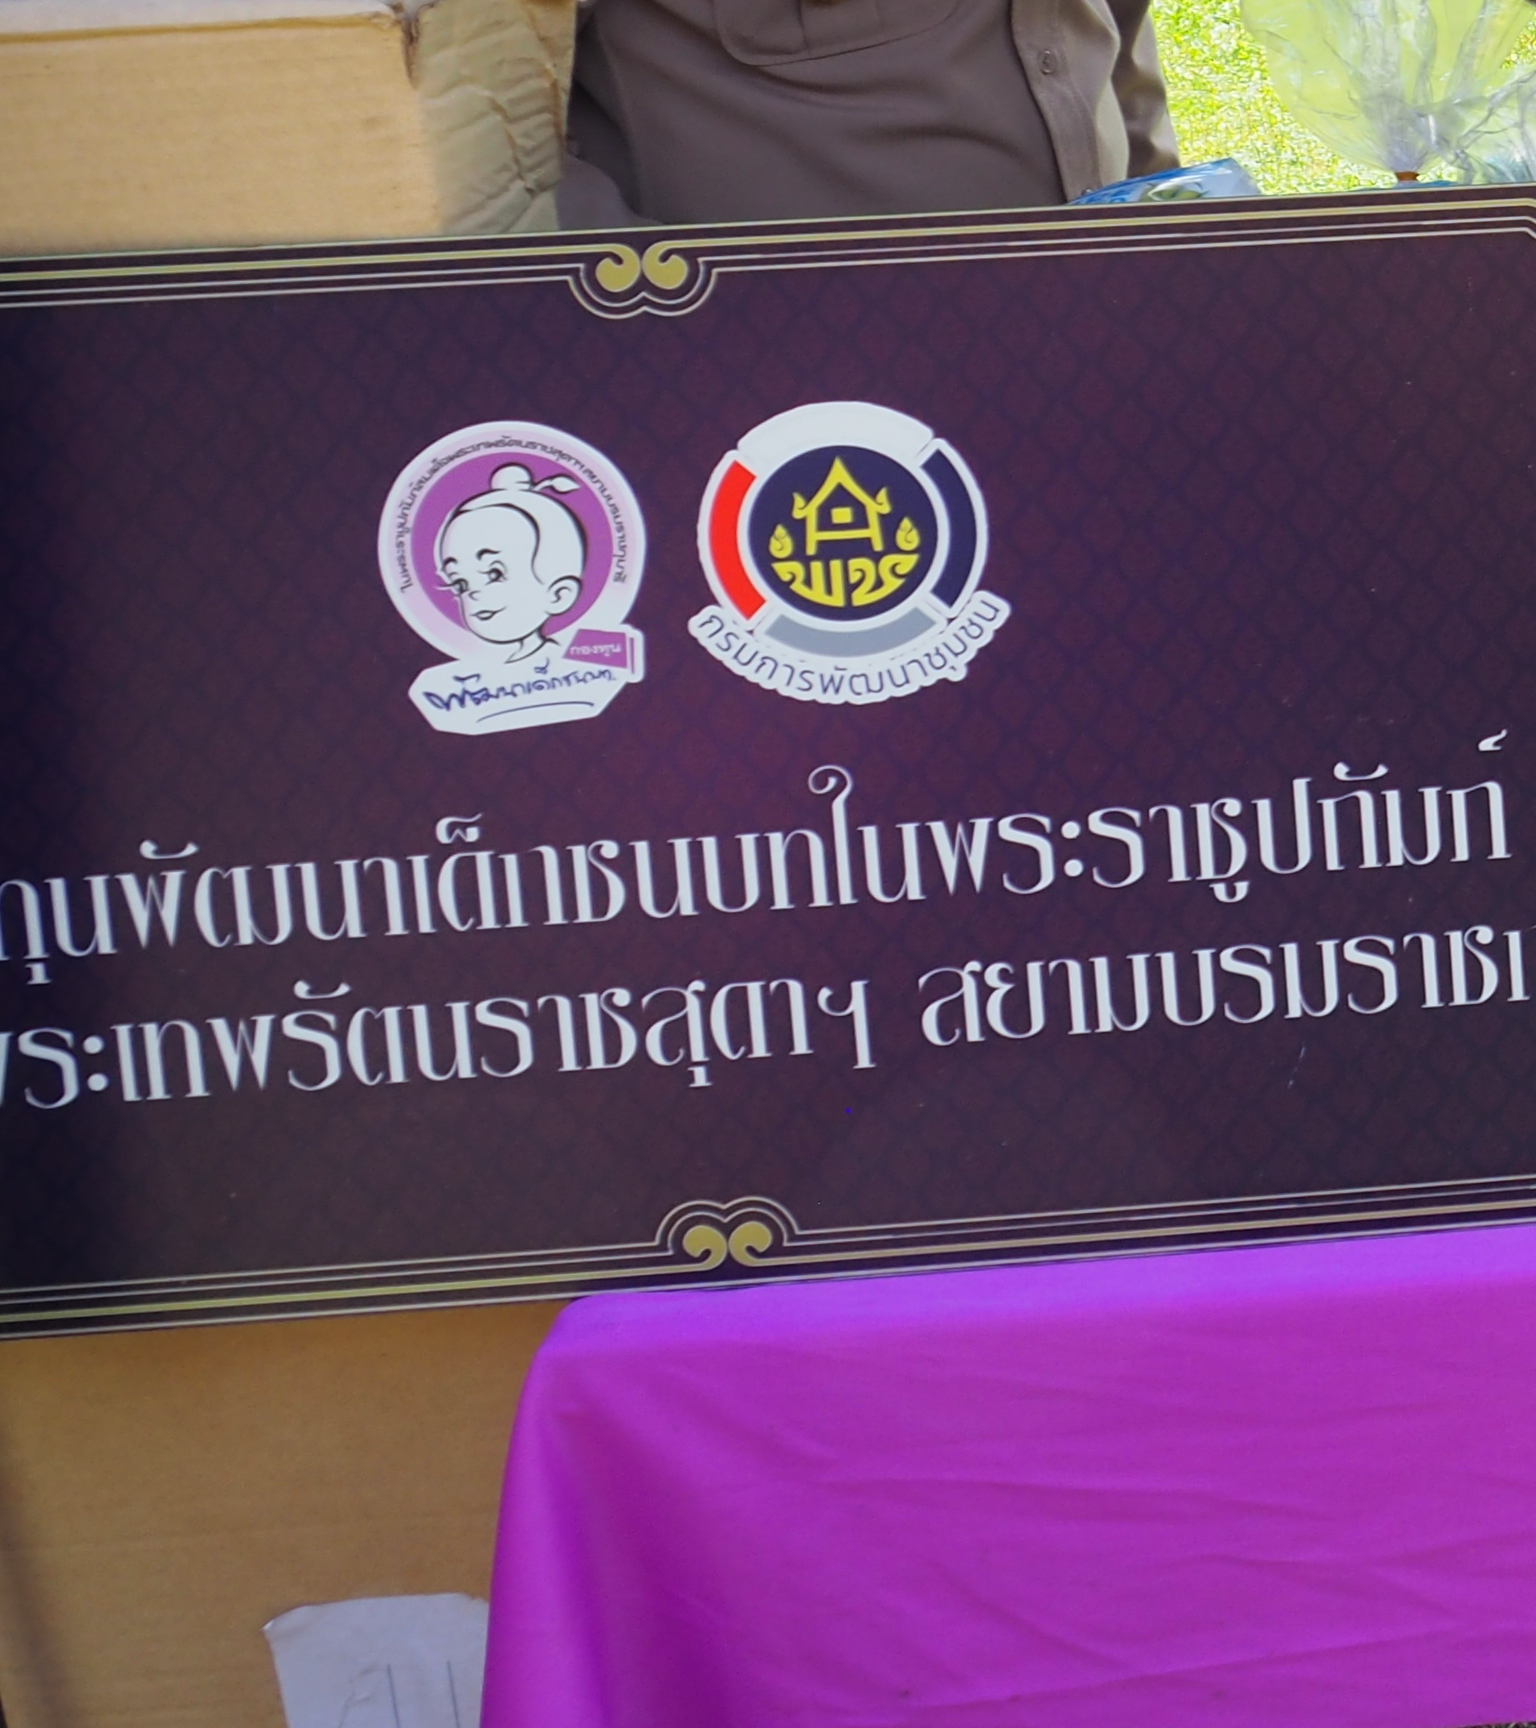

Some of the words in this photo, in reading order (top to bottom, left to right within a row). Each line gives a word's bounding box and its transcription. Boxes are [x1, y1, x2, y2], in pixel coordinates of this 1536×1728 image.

[698, 599, 1000, 696] กรมการพัฒนาชุมชน
[0, 975, 877, 1111] ระเทพรัตนราชสุดาฯ
